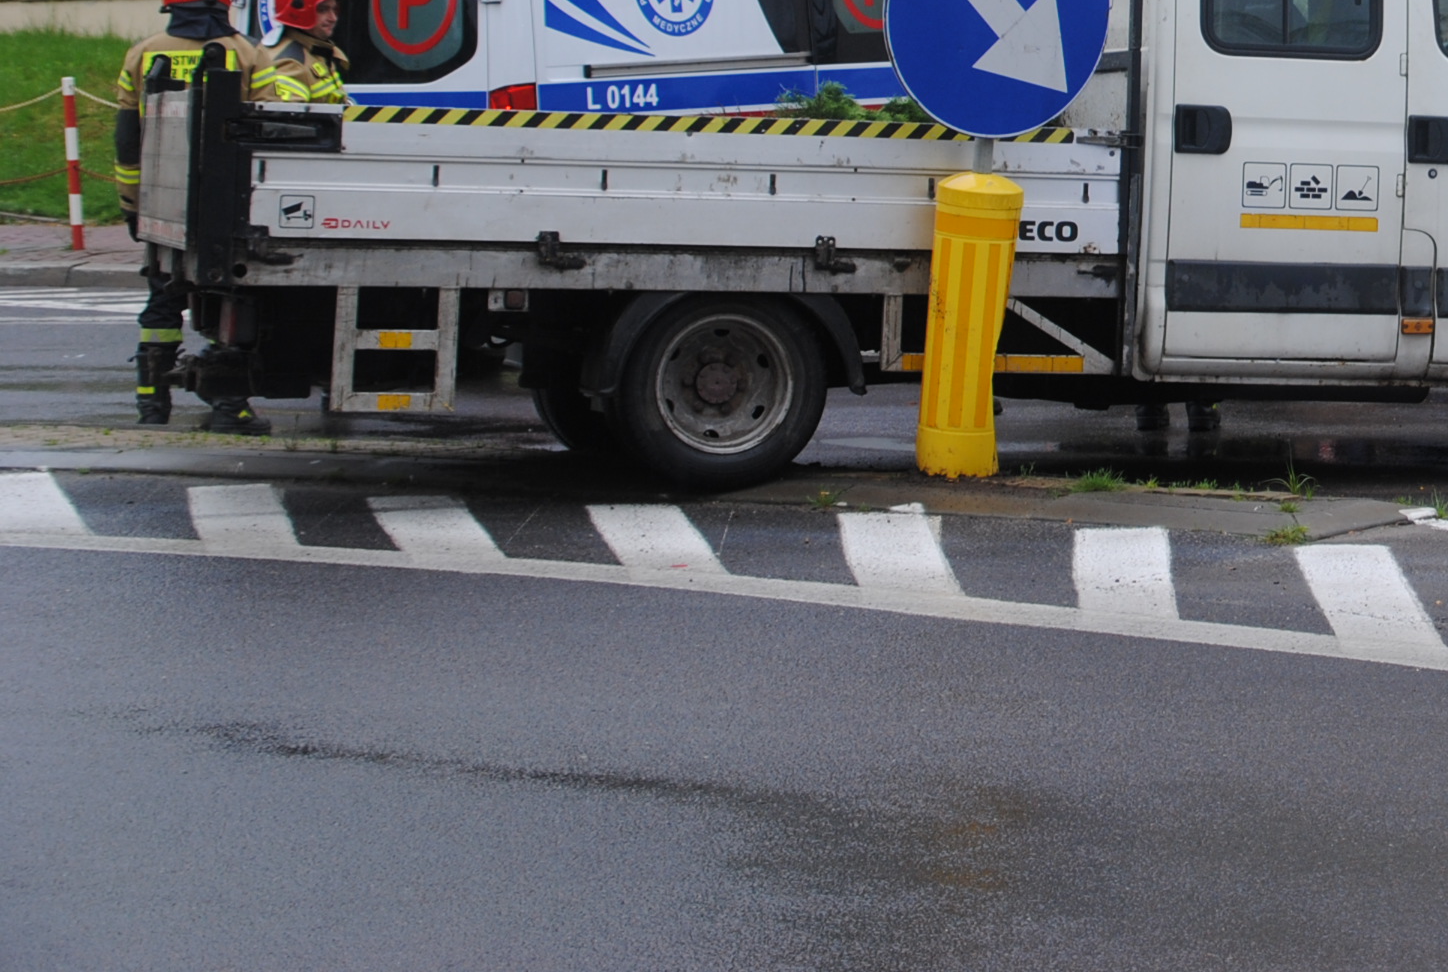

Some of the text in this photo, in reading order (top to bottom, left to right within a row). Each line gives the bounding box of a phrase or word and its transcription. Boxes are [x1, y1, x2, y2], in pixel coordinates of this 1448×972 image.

[652, 12, 704, 33] MEDYCZNE
[586, 83, 660, 110] L 0144
[341, 219, 391, 229] DAILY
[1019, 220, 1079, 242] ECO
